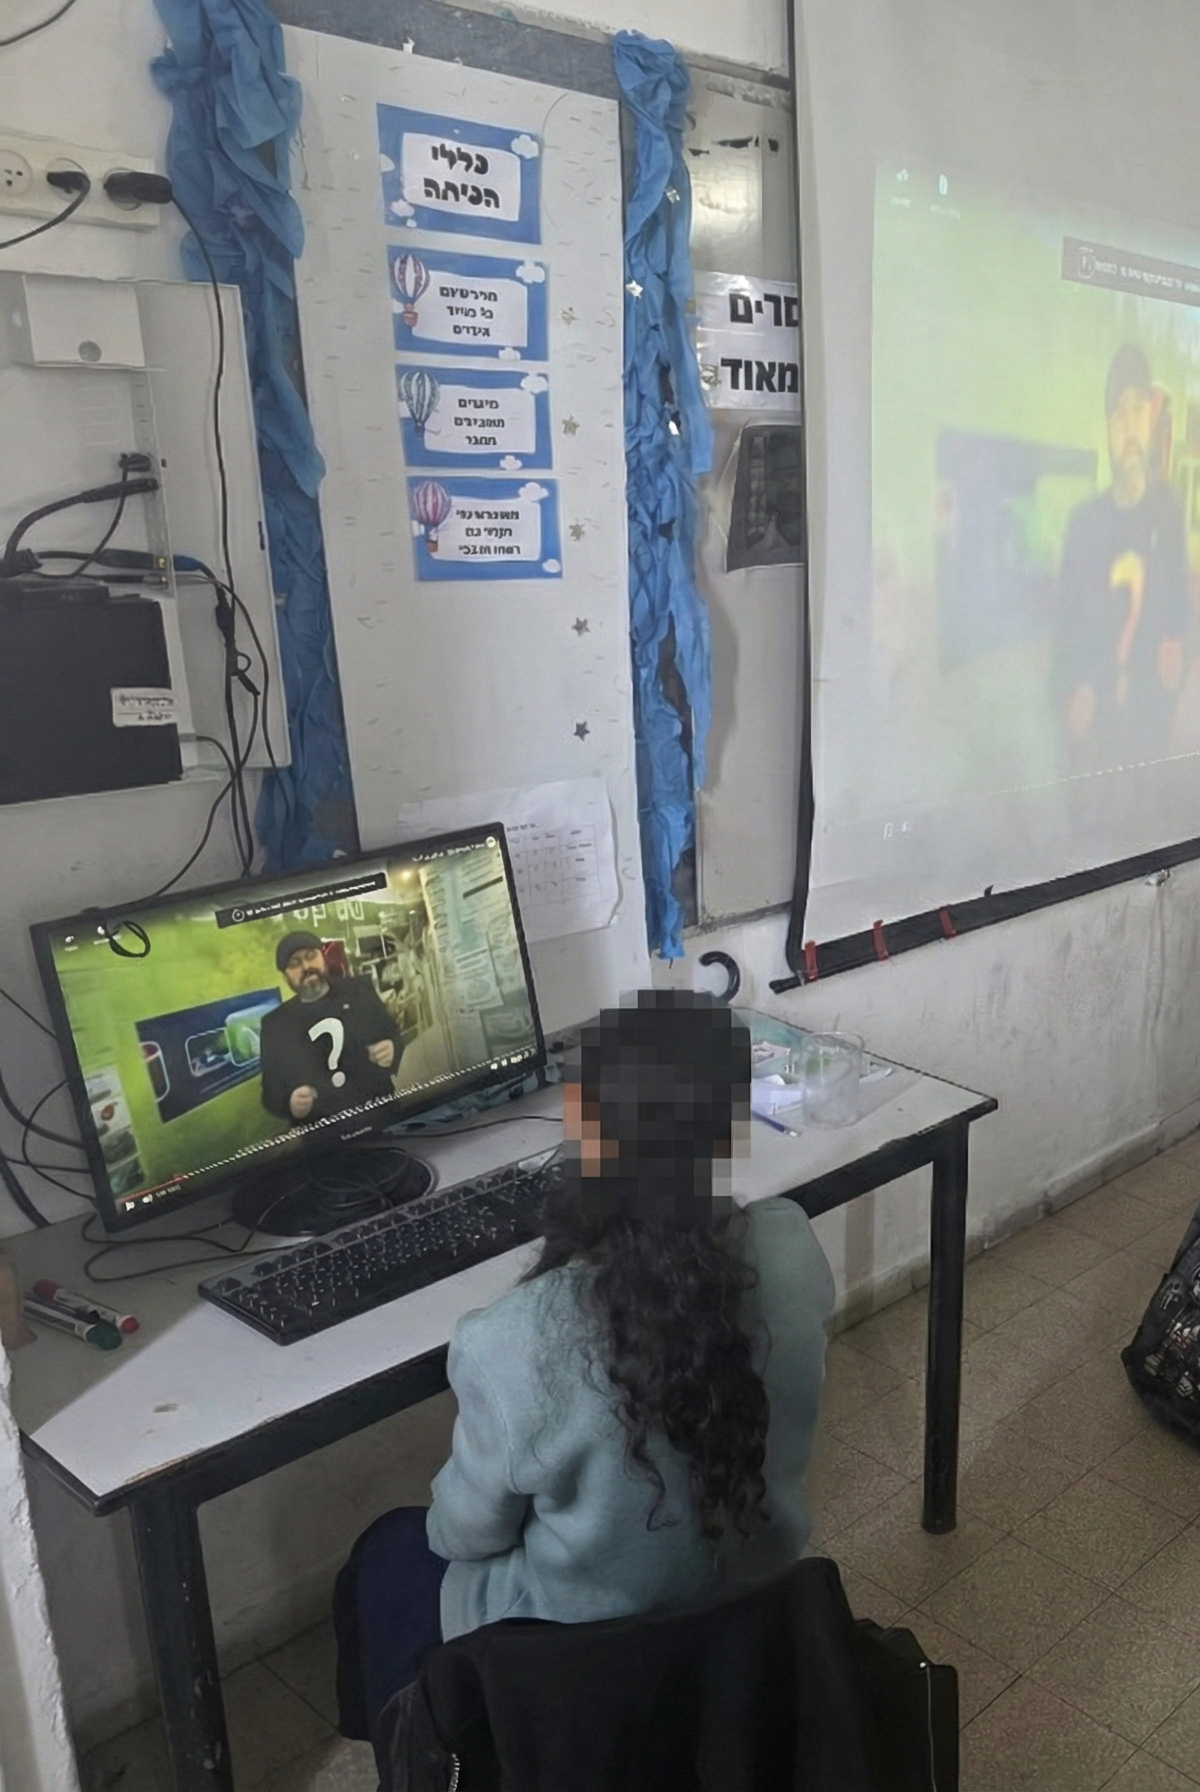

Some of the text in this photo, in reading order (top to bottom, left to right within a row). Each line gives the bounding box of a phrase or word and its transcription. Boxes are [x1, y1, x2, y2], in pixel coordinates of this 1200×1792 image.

[431, 143, 489, 175] כללי
[423, 177, 500, 209] הכיתה
[721, 358, 799, 394] מאוד
